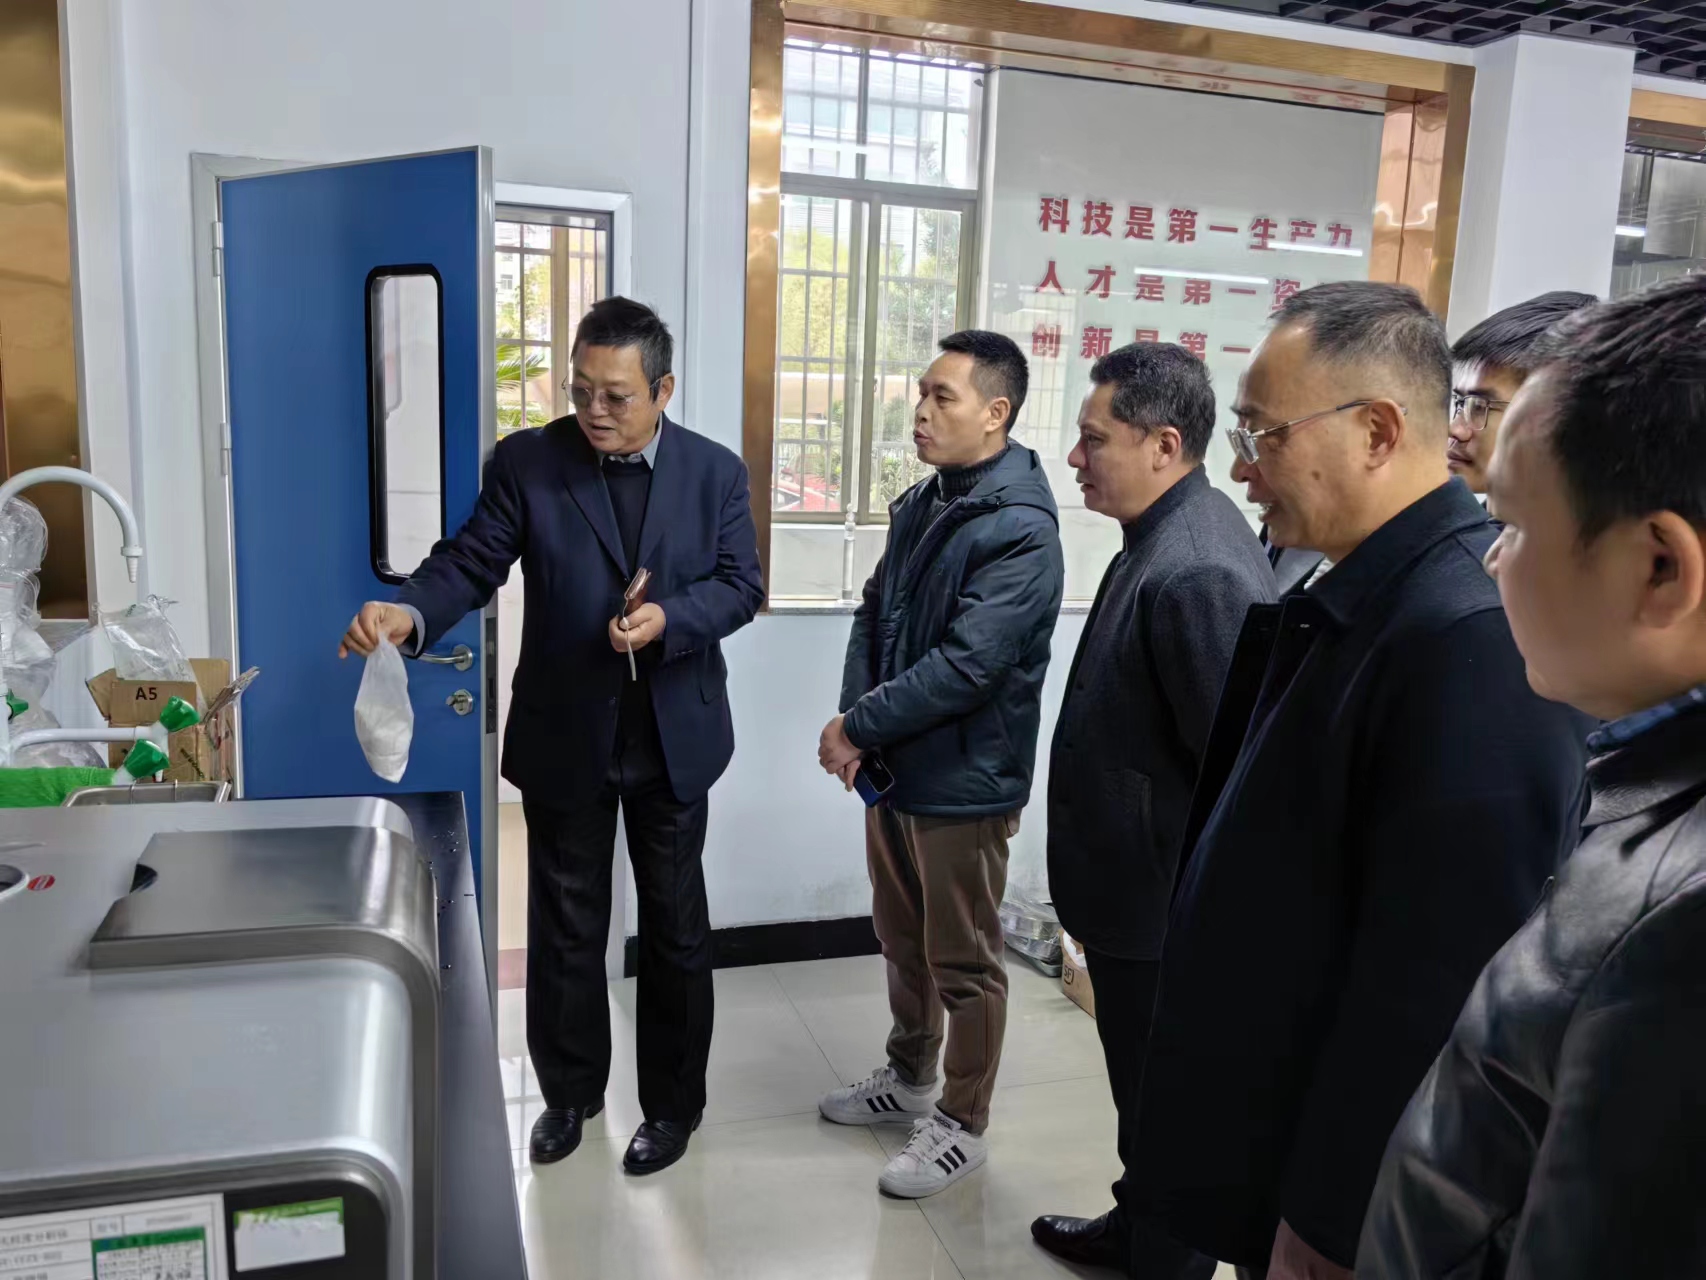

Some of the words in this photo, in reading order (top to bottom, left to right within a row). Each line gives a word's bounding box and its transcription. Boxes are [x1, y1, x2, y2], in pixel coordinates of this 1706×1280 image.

[1038, 197, 1353, 251] 科技是第一生产力
[135, 686, 158, 701] A5
